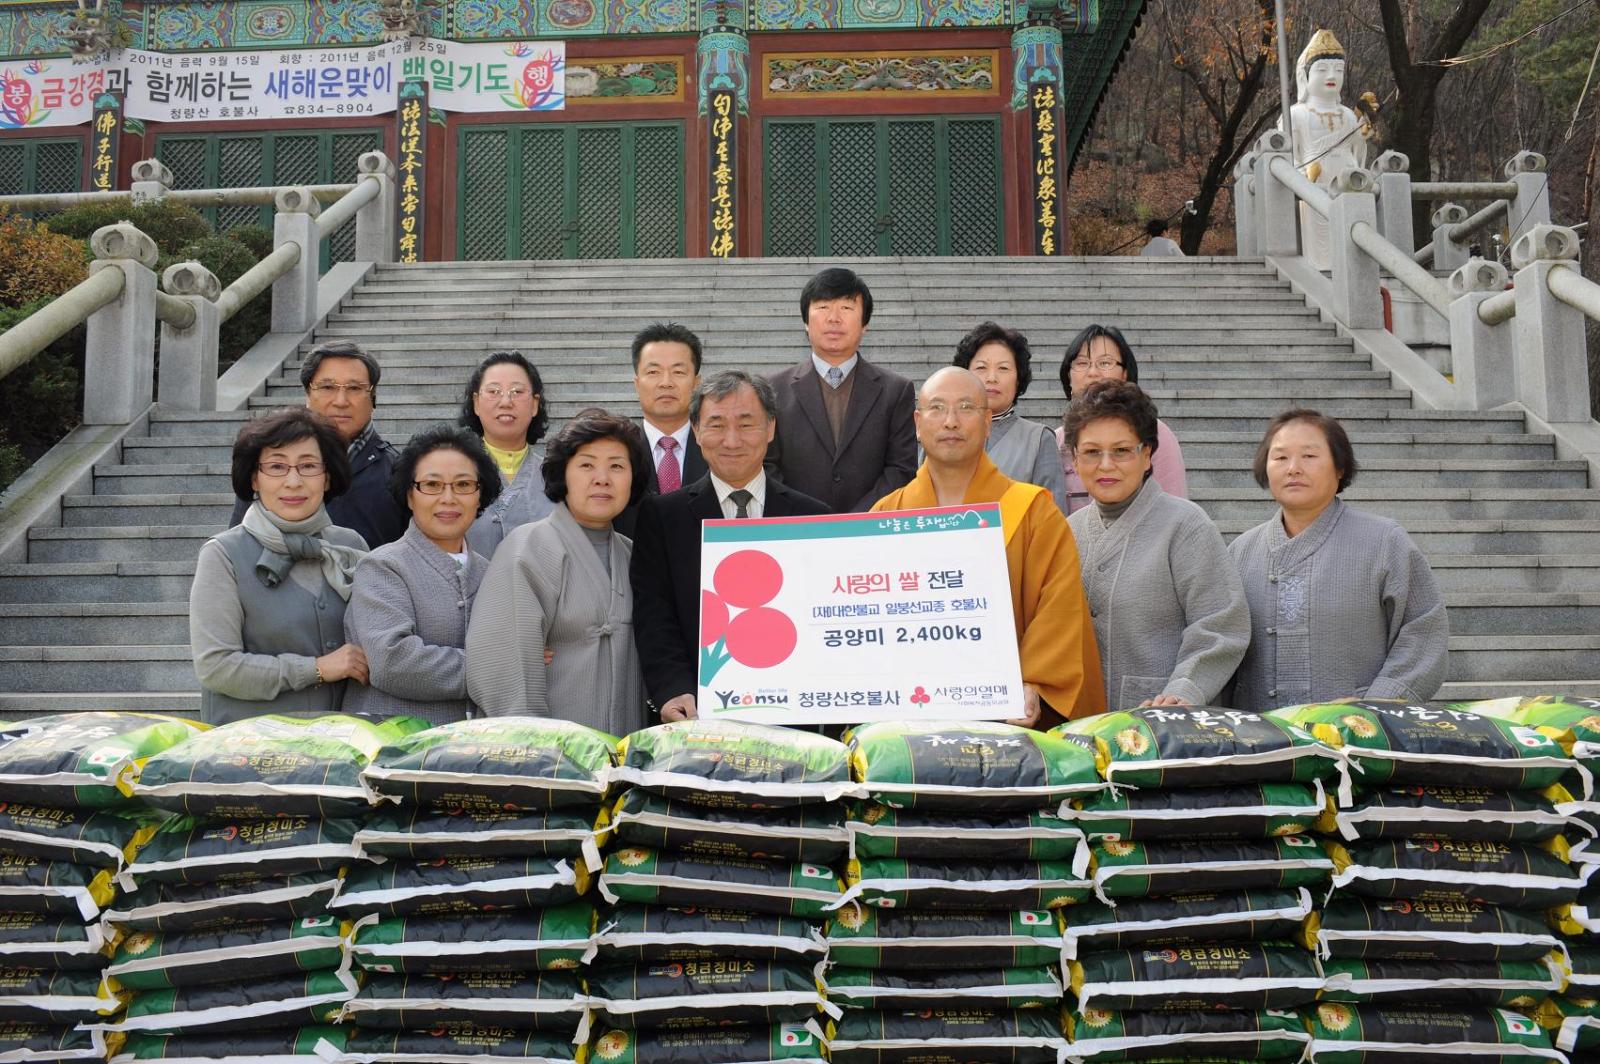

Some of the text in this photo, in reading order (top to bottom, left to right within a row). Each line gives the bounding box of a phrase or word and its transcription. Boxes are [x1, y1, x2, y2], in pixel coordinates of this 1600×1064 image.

[130, 53, 173, 68] 2011년
[180, 55, 202, 68] 음력
[209, 56, 228, 67] 9월
[235, 55, 260, 66] 15일
[280, 54, 302, 65] 회향
[320, 52, 359, 63] 2011년
[367, 49, 386, 62] 음력
[391, 41, 412, 55] 12월
[419, 41, 447, 55] 25일
[41, 56, 510, 108] 금강경과 함께하는 새해운맞이 백일기도
[527, 66, 548, 88] 행
[7, 83, 26, 104] 봉
[170, 106, 259, 119] 청량산 호불사
[297, 103, 374, 115] 834-8904
[879, 516, 960, 532] 나눔은 투자입니다
[832, 570, 964, 594] 사랑의 쌀 전달
[886, 601, 945, 615] 일붕선교종
[951, 597, 987, 612] 호불사
[824, 625, 982, 648] 공양미 2,400kg
[715, 690, 788, 709] Yeonsu
[799, 691, 901, 708] 청량산호불사
[934, 685, 1008, 701] 사랑의열매
